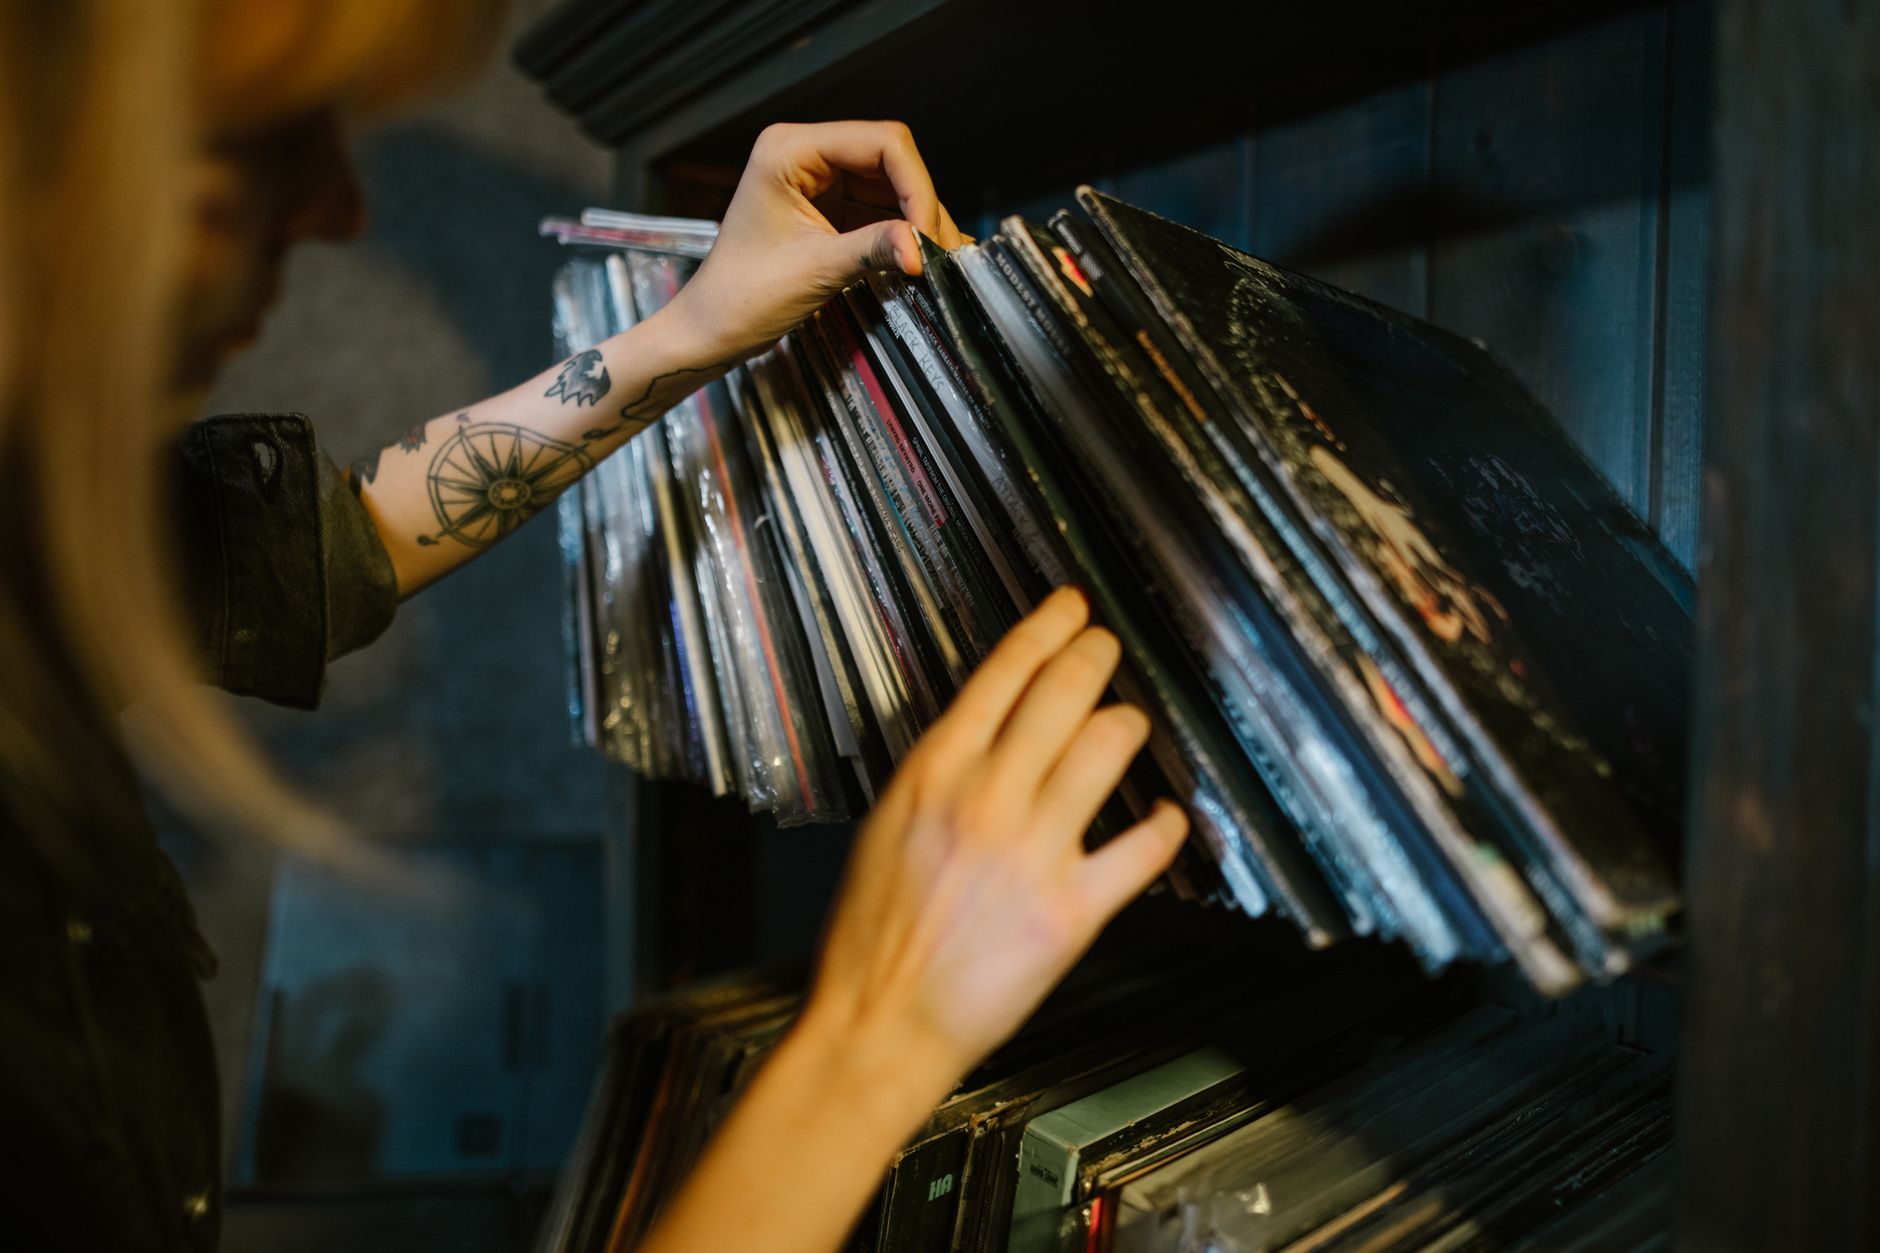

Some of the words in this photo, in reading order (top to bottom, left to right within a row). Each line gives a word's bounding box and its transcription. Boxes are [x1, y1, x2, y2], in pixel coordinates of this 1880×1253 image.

[993, 251, 1037, 309] MODEST
[886, 303, 922, 352] BLACK
[917, 353, 947, 392] KEYS
[885, 418, 901, 443] LYNYRD
[897, 442, 916, 473] SKYNYRD
[915, 479, 927, 495] ONE
[922, 494, 937, 516] MORE
[910, 436, 925, 458] SPINAL
